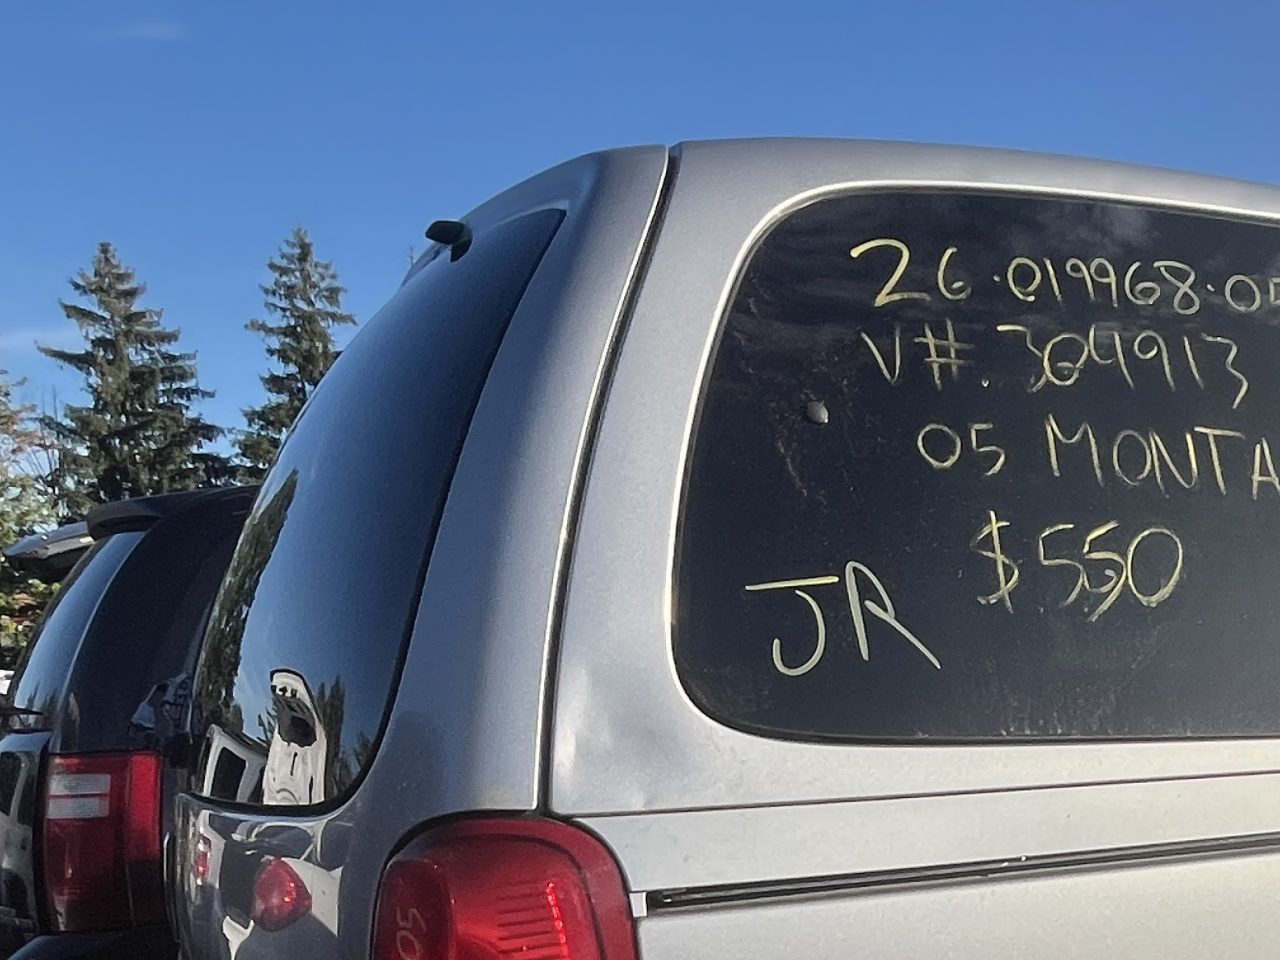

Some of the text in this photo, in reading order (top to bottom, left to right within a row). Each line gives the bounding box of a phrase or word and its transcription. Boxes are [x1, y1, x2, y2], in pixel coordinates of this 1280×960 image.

[917, 422, 1005, 476] 05
[745, 561, 942, 676] JR
[968, 510, 1184, 622] $550
